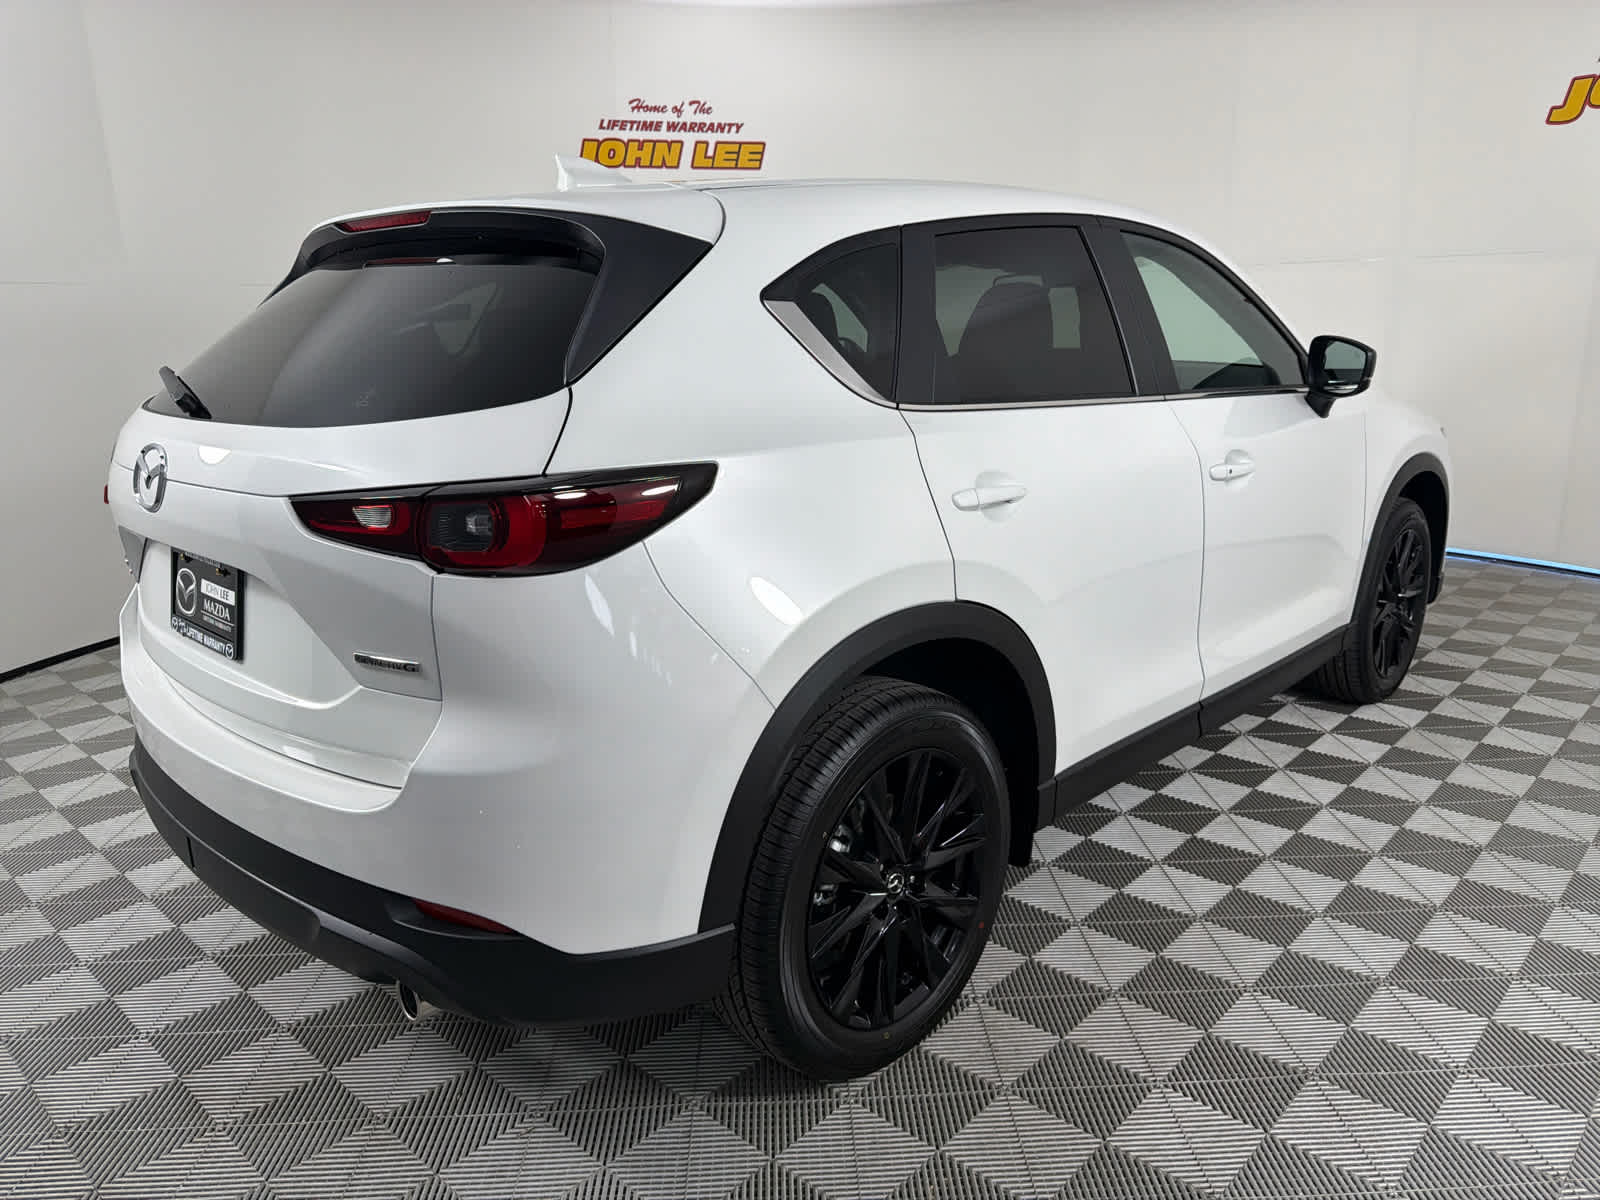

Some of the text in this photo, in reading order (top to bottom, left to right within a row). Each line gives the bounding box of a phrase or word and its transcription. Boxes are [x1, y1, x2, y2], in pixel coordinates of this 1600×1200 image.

[628, 98, 713, 118] Home of The
[598, 119, 744, 134] LIFETIME WARRANTY
[691, 141, 766, 170] LEE
[219, 589, 230, 601] LEE
[203, 598, 231, 622] MAZDA
